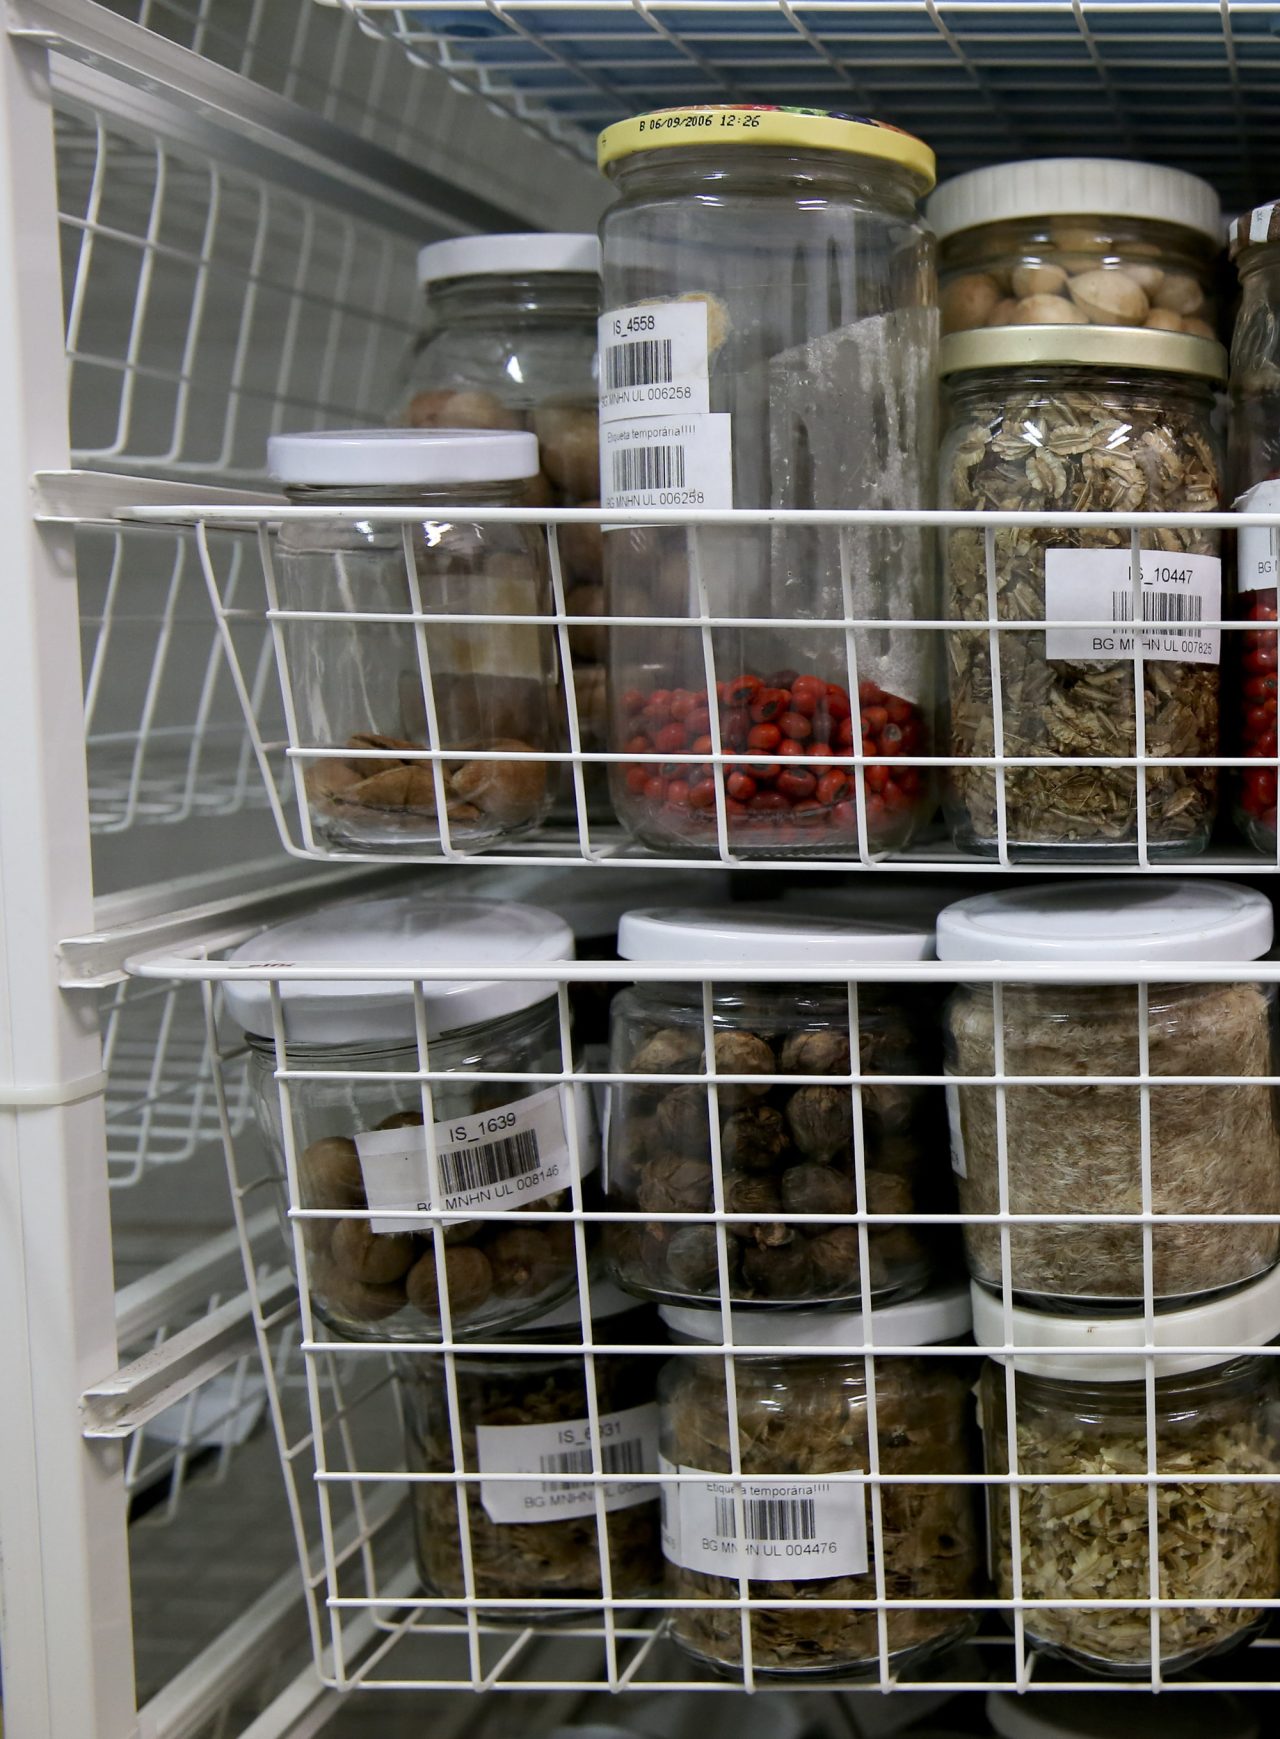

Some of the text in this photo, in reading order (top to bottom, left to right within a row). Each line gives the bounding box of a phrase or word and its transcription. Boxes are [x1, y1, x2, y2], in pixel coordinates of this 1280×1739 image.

[649, 115, 713, 131] 06/09/2006
[719, 114, 761, 128] 12:26
[613, 315, 655, 338] IS_4558
[632, 391, 645, 402] UL
[647, 386, 692, 401] 006258
[642, 493, 657, 506] UL
[659, 490, 705, 505] 006258
[1257, 561, 1273, 574] BG
[1092, 637, 1115, 651] BG
[1163, 639, 1179, 653] UL
[1181, 639, 1213, 656] 007825
[449, 1112, 516, 1143] IS_1639
[445, 1188, 491, 1211] MNHN
[495, 1182, 513, 1198] UL
[516, 1164, 559, 1191] 008146
[707, 1483, 747, 1495] Etiquea
[524, 1496, 546, 1509] BG
[702, 1537, 718, 1552] BG
[763, 1544, 781, 1557] UL
[785, 1541, 837, 1556] 004476
